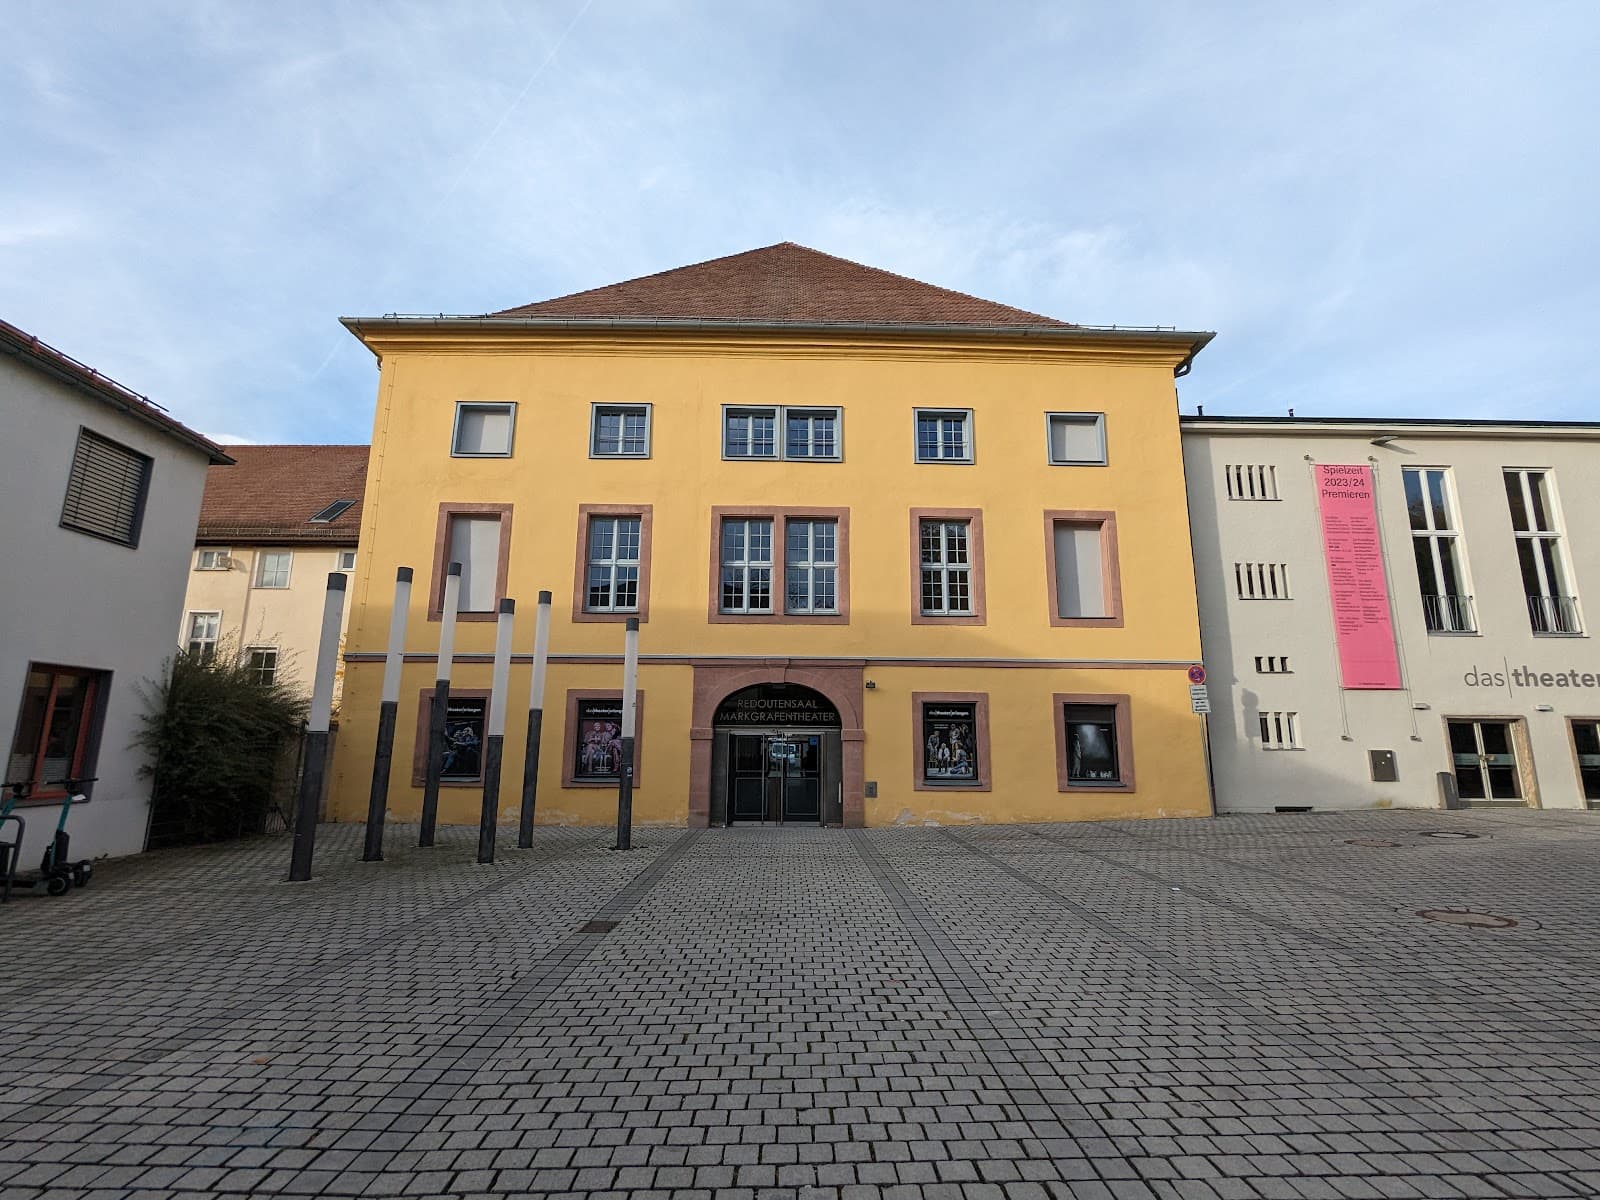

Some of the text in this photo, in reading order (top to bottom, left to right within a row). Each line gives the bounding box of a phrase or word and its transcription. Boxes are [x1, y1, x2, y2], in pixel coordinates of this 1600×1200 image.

[1323, 465, 1364, 475] Spielzeit
[1324, 478, 1365, 487] 2023/24
[1321, 489, 1370, 499] Premieren
[1463, 665, 1505, 687] das
[737, 699, 818, 709] REDOUTENSAAL
[720, 711, 836, 721] MARKGRAFENTHEATER
